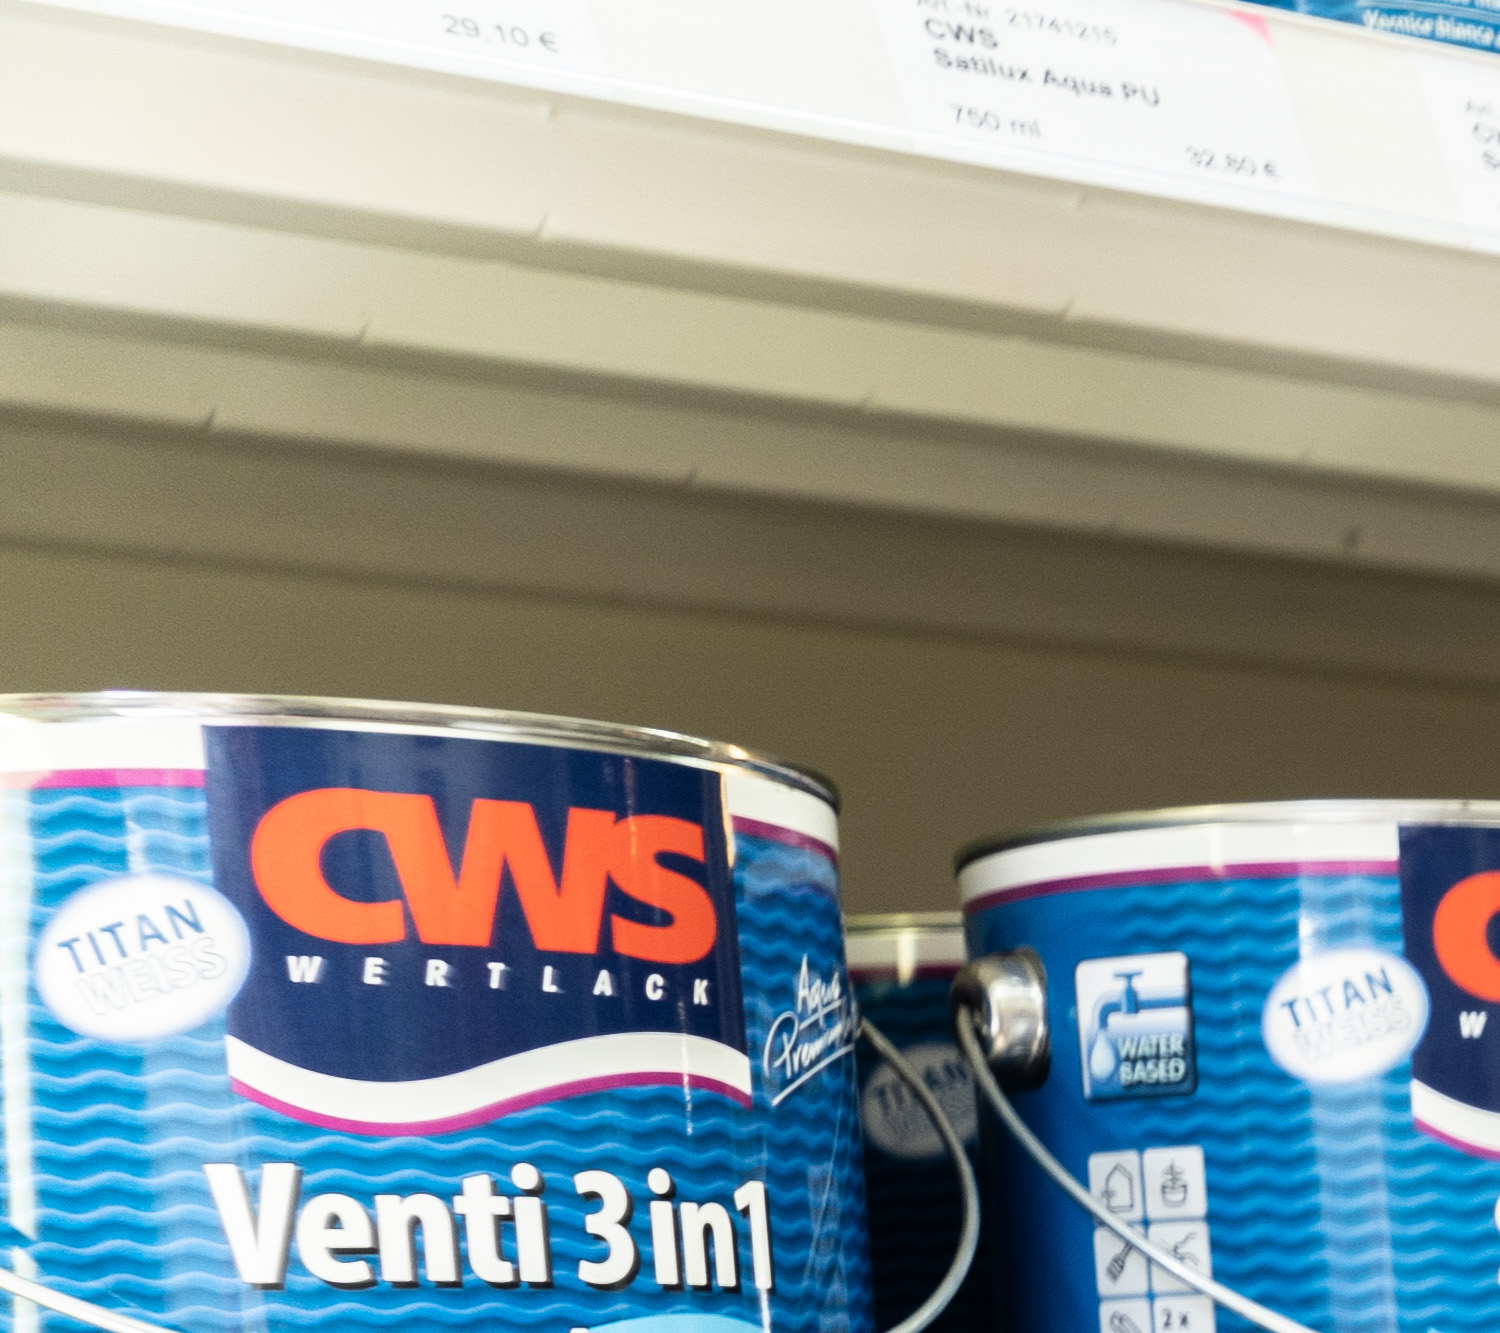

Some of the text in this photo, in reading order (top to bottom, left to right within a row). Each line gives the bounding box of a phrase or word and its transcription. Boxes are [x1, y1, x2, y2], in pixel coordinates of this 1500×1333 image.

[539, 32, 559, 53] €
[925, 18, 998, 50] CWS
[949, 102, 1000, 131] 750
[251, 788, 718, 964] CWS
[56, 895, 204, 973] TITAN
[288, 955, 714, 1006] WERTLACK
[1281, 967, 1395, 1030] TITAN
[1119, 1034, 1184, 1062] WATER
[1120, 1059, 1186, 1087] BASED
[204, 1162, 555, 1292] Venti
